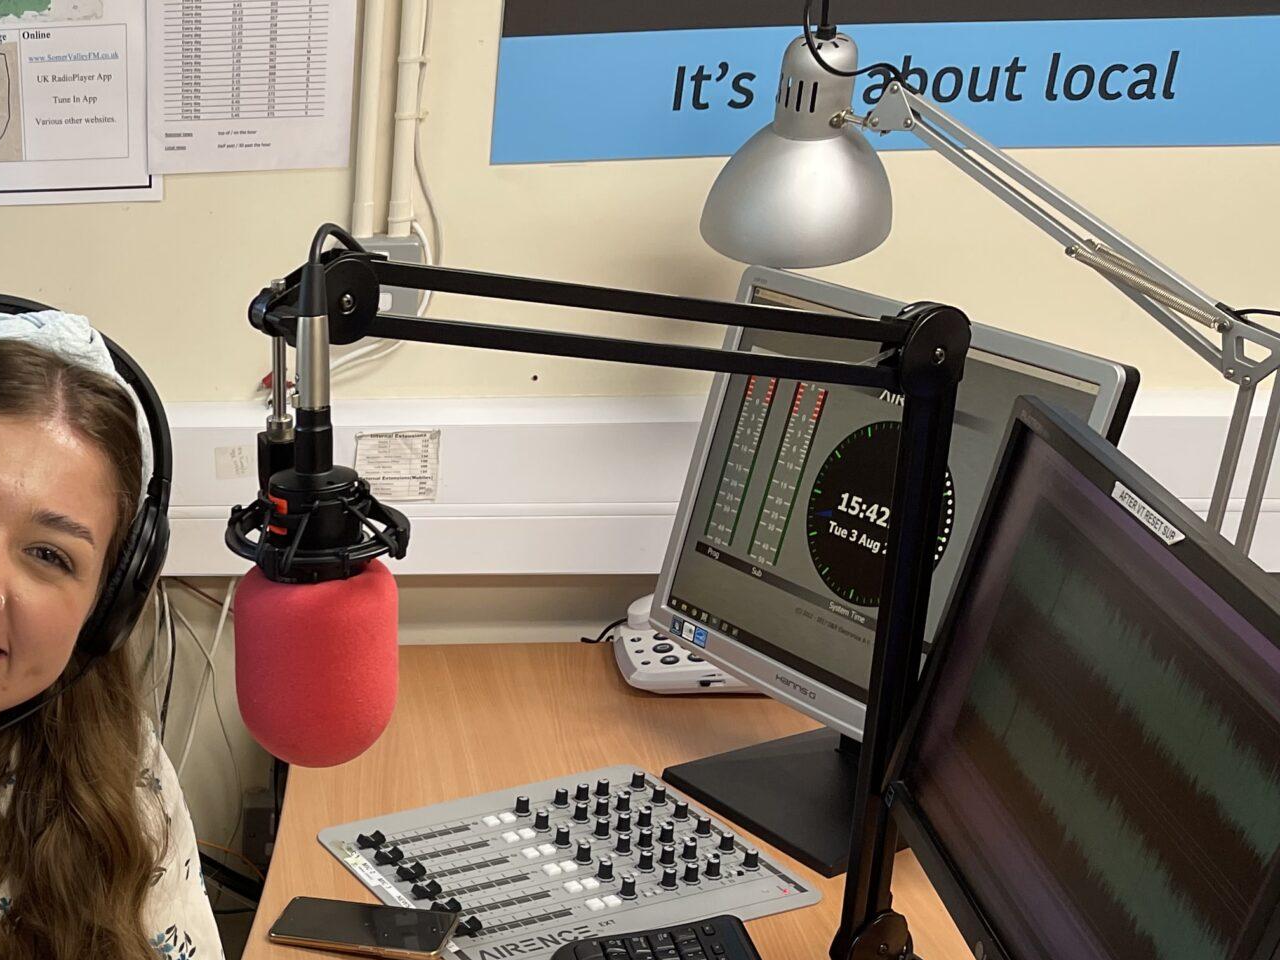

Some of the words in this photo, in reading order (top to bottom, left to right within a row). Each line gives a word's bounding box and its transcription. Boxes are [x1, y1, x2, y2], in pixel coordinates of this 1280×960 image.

[22, 31, 51, 40] Online
[36, 74, 49, 83] UK
[51, 73, 95, 84] RadioPlayer
[96, 73, 112, 83] App
[1045, 50, 1181, 101] local
[53, 96, 70, 104] Tune
[82, 96, 98, 104] App
[35, 117, 62, 126] Various
[64, 116, 82, 125] other
[1119, 491, 1138, 513] AFTER
[1144, 509, 1163, 530] RESET
[829, 520, 847, 536] Tue
[849, 528, 858, 540] 3
[858, 532, 880, 554] Aug
[708, 547, 720, 560] Prog
[752, 567, 762, 577] Sub
[829, 601, 849, 618] System
[851, 612, 866, 624] Time
[598, 919, 616, 927] EXT
